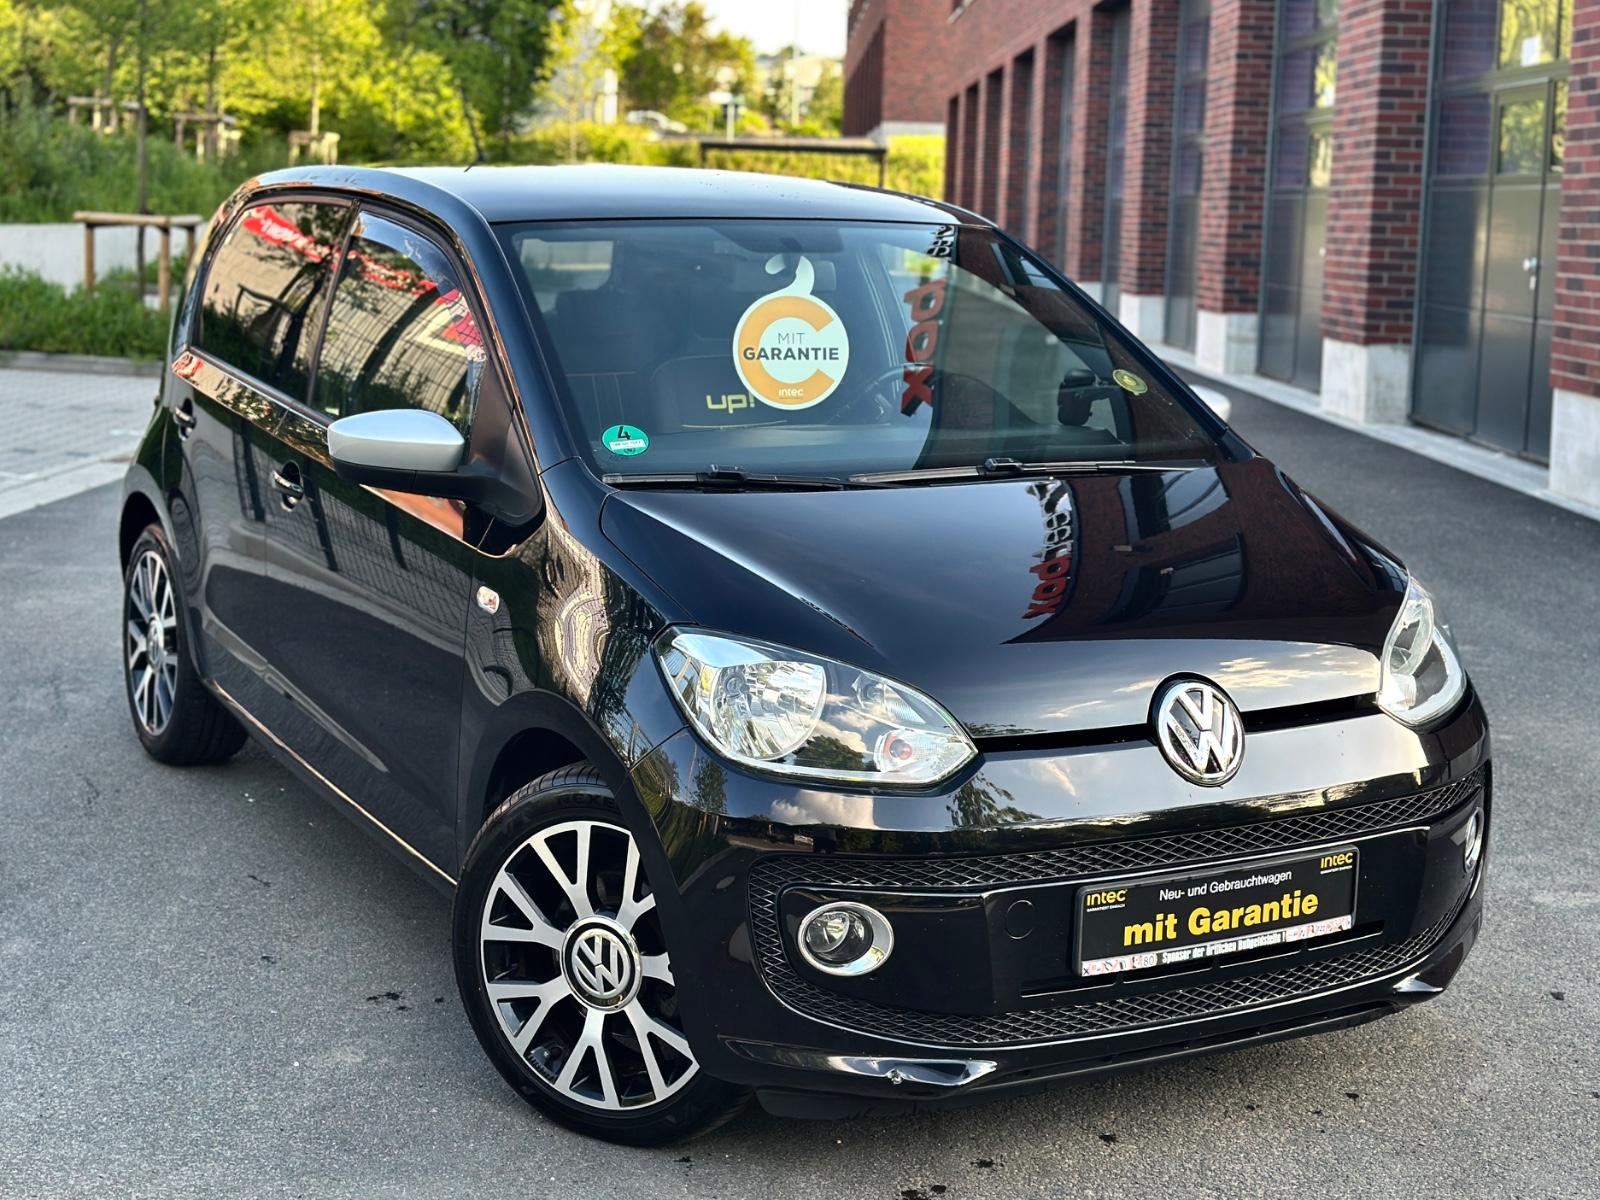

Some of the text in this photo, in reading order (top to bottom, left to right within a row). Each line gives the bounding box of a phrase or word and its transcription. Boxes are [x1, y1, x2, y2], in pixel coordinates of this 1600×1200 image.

[777, 332, 806, 345] MIT
[743, 347, 840, 361] GARANTIE
[778, 387, 804, 397] intec
[706, 390, 755, 414] up!
[617, 426, 631, 440] 4
[1158, 682, 1244, 786] VW
[1320, 852, 1354, 869] intec
[1159, 870, 1292, 902] Neu- und Gebrauchtwagen
[1086, 890, 1127, 906] intec
[1123, 889, 1319, 946] mit Garantie
[571, 928, 631, 999] VW
